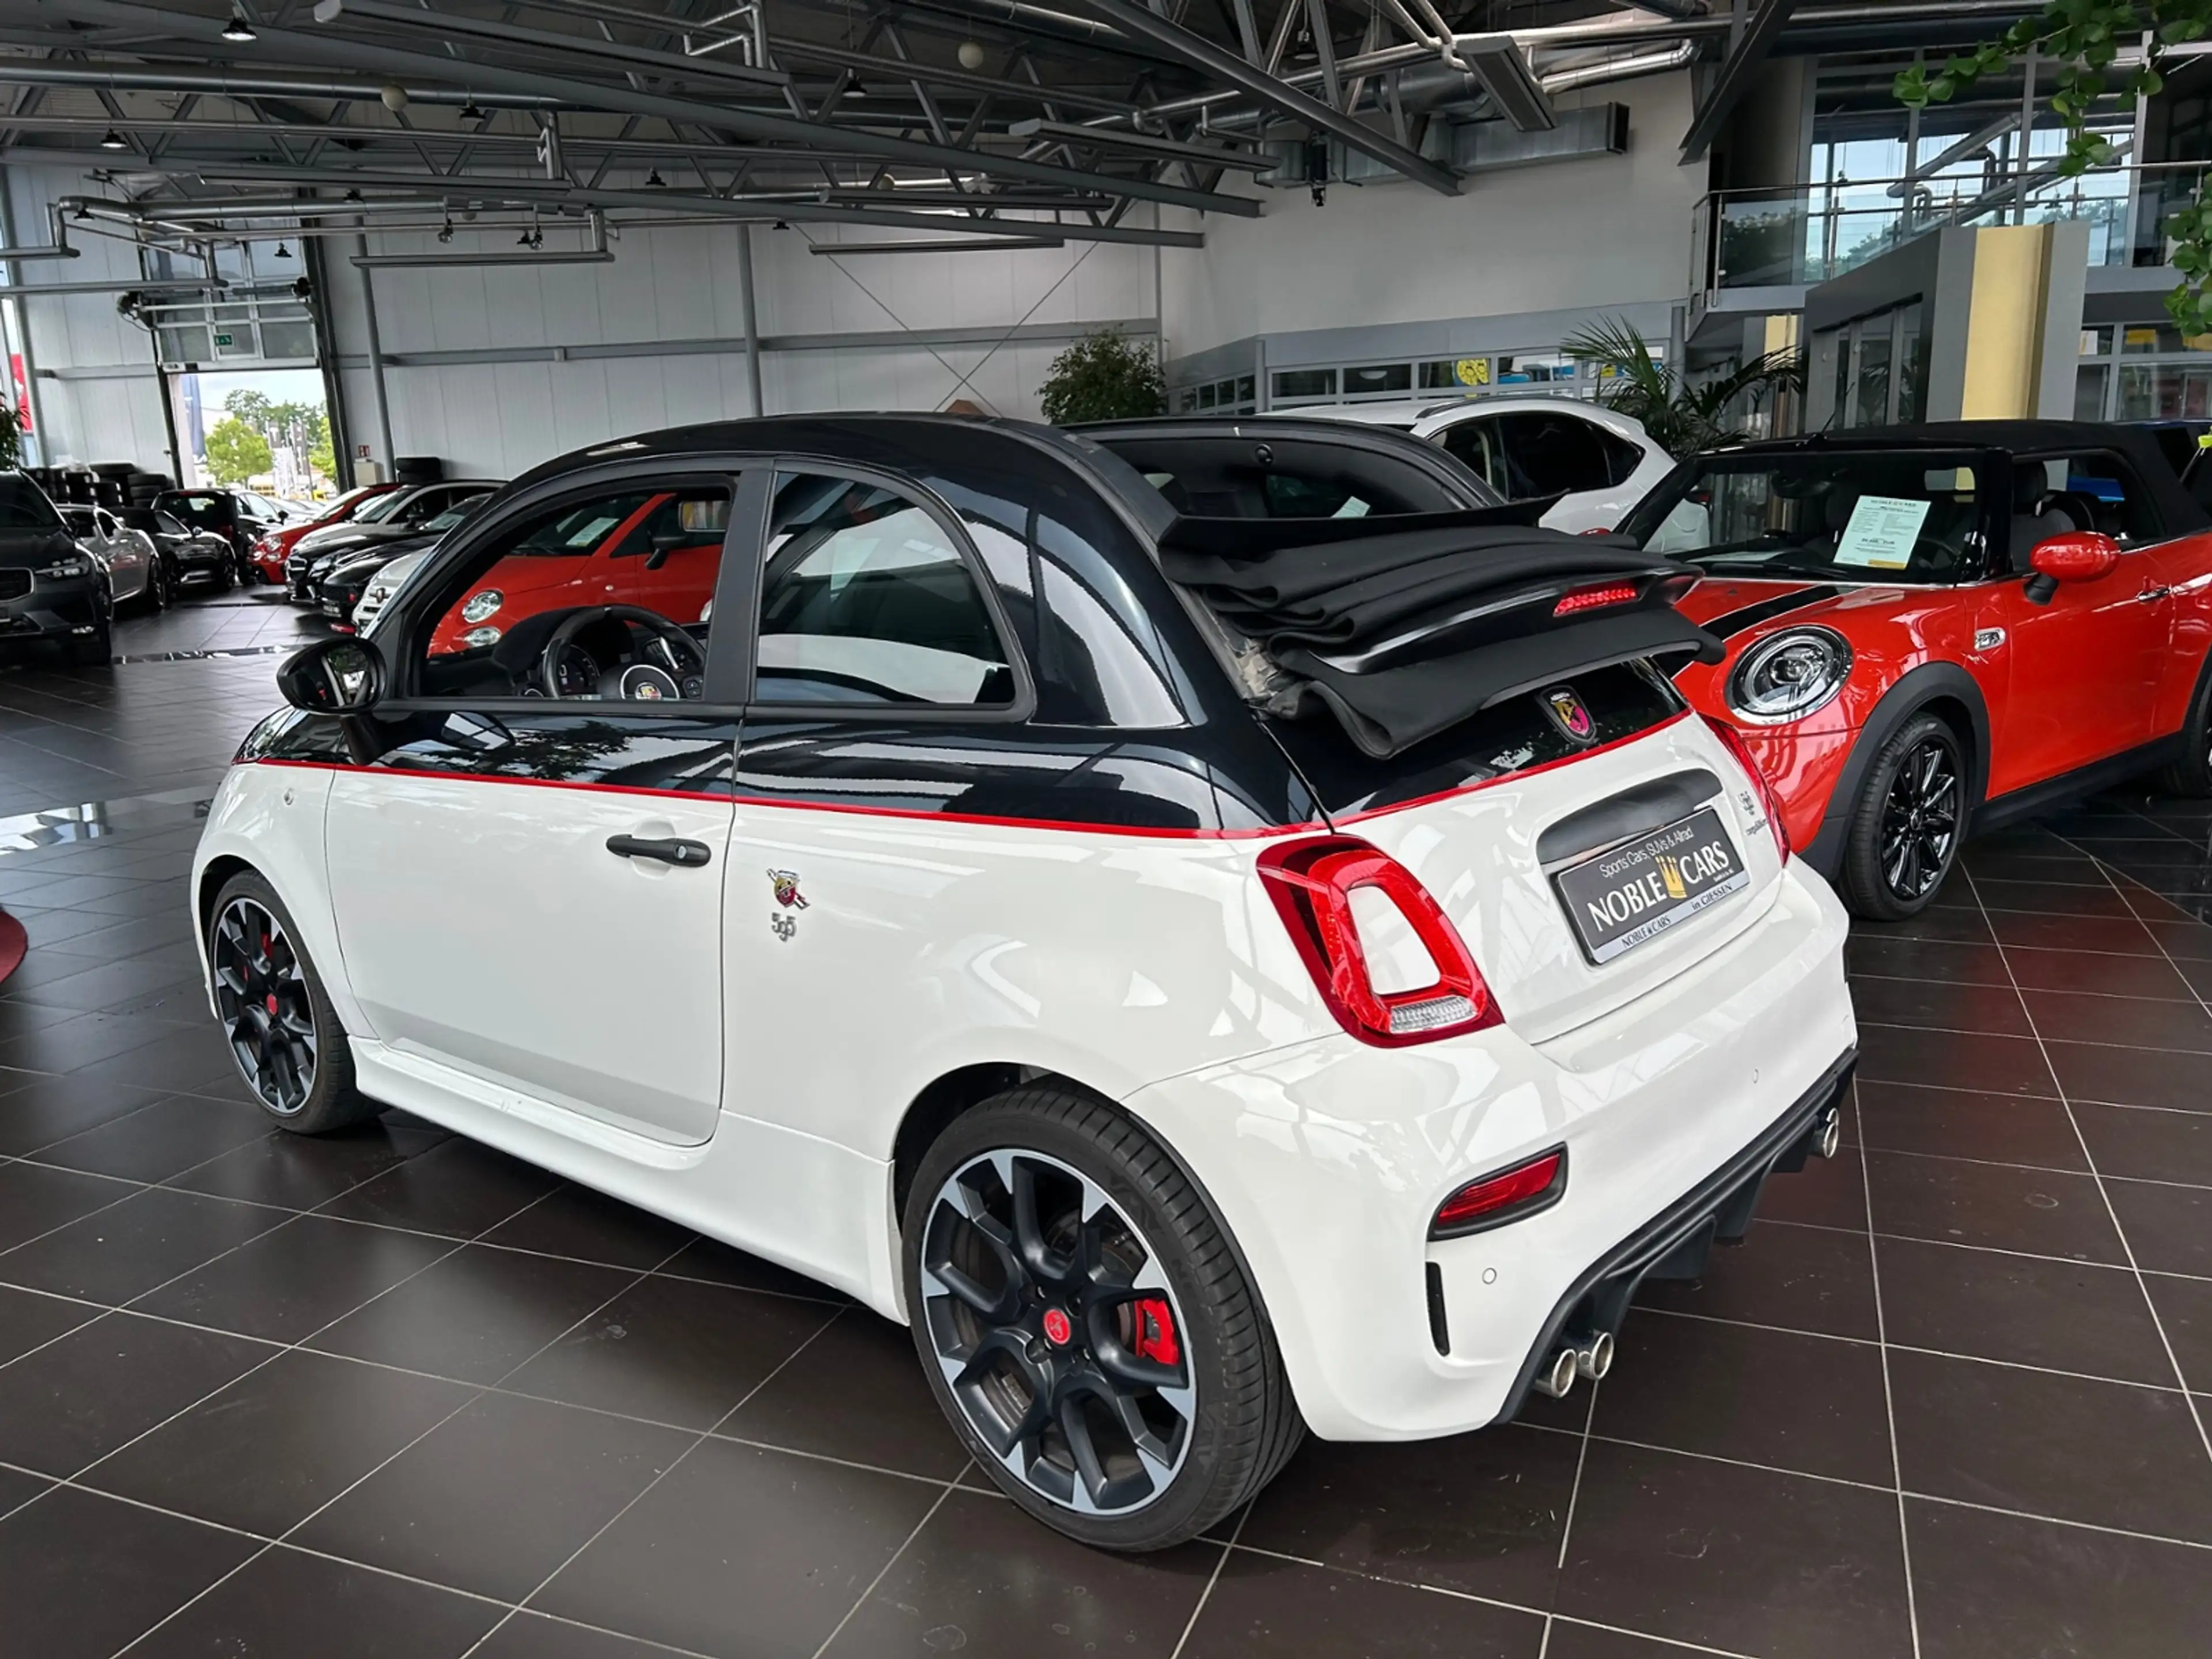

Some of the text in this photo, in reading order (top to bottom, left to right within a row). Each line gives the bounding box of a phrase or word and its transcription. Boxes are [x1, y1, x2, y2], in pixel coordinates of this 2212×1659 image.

[1599, 857, 1629, 878] Sports
[1673, 825, 1694, 844] Allrad
[1587, 840, 1729, 932] NOBLE CARS
[1622, 915, 1671, 948] NOBLE CARS
